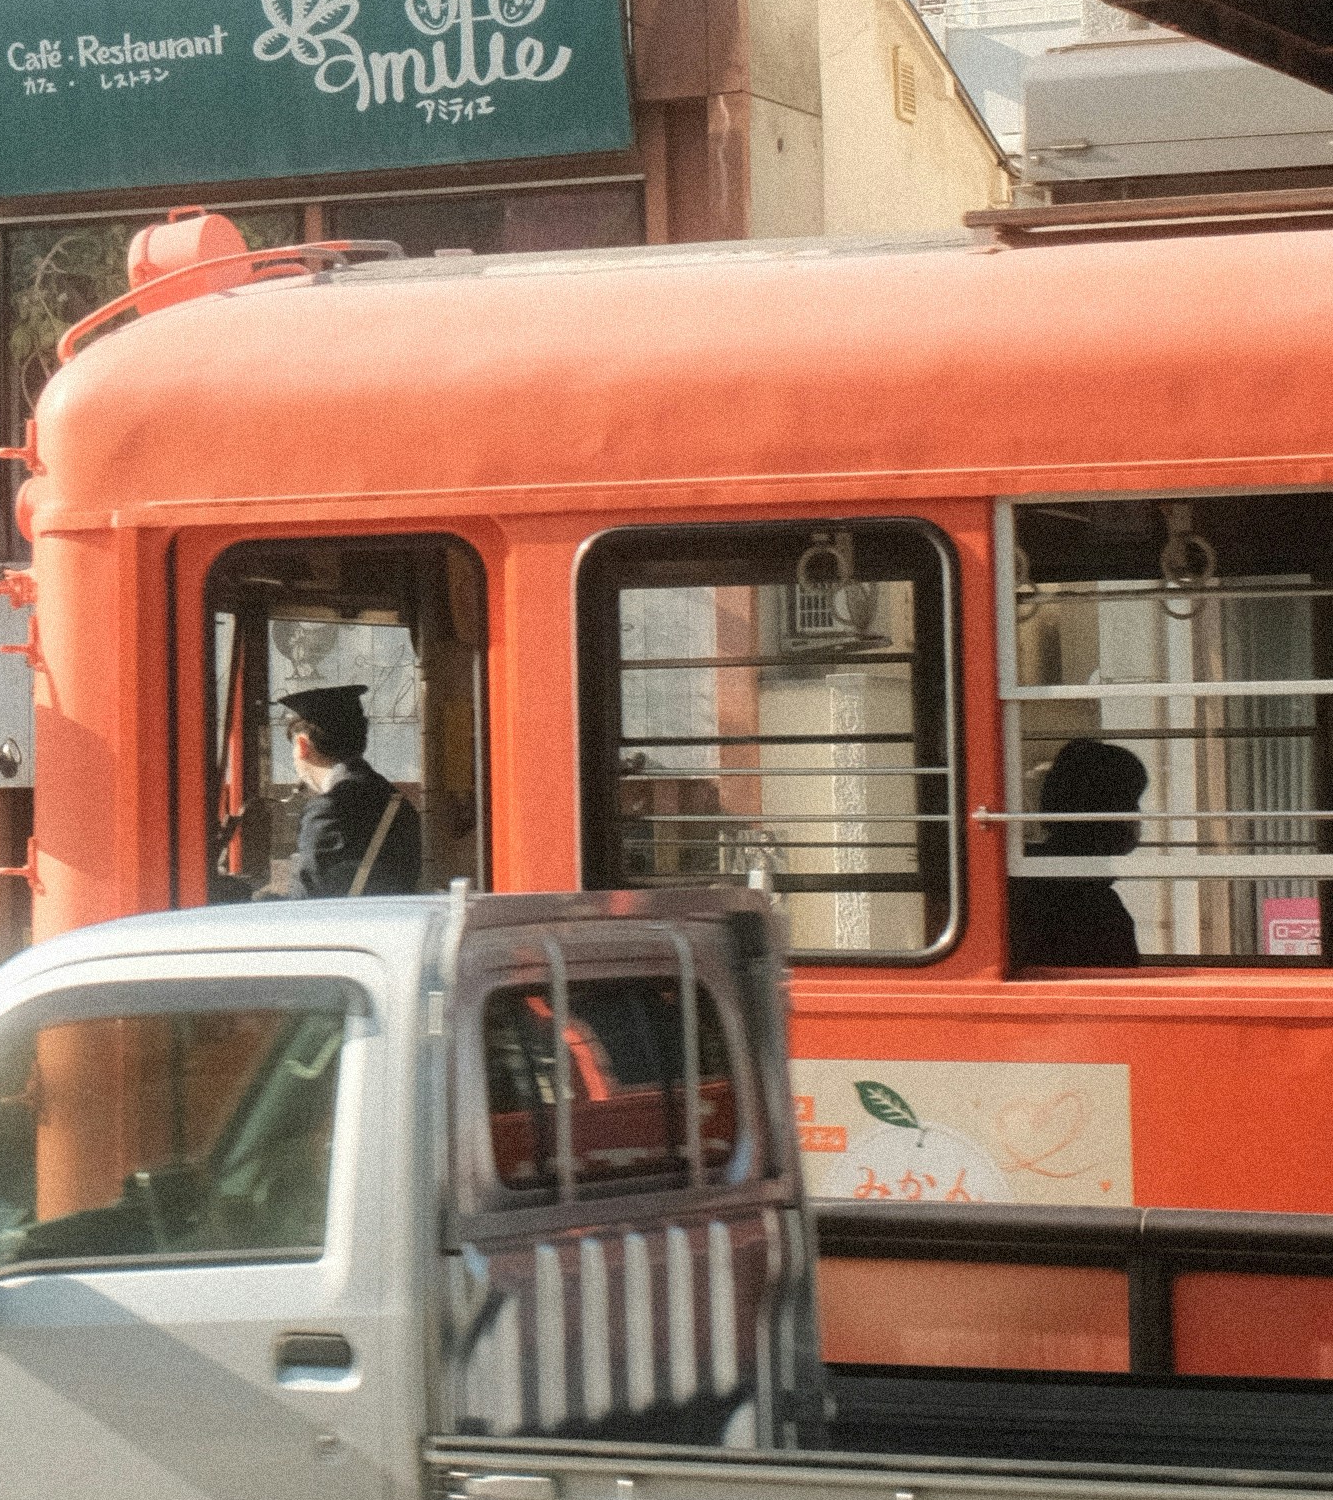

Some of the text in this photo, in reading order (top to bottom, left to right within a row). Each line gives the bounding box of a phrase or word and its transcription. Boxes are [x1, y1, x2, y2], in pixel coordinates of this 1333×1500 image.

[7, 39, 62, 71] Café
[77, 24, 229, 67] Restaurant
[23, 76, 58, 96] カフェ
[99, 67, 170, 90] レストラン
[415, 95, 496, 124] アミティエ
